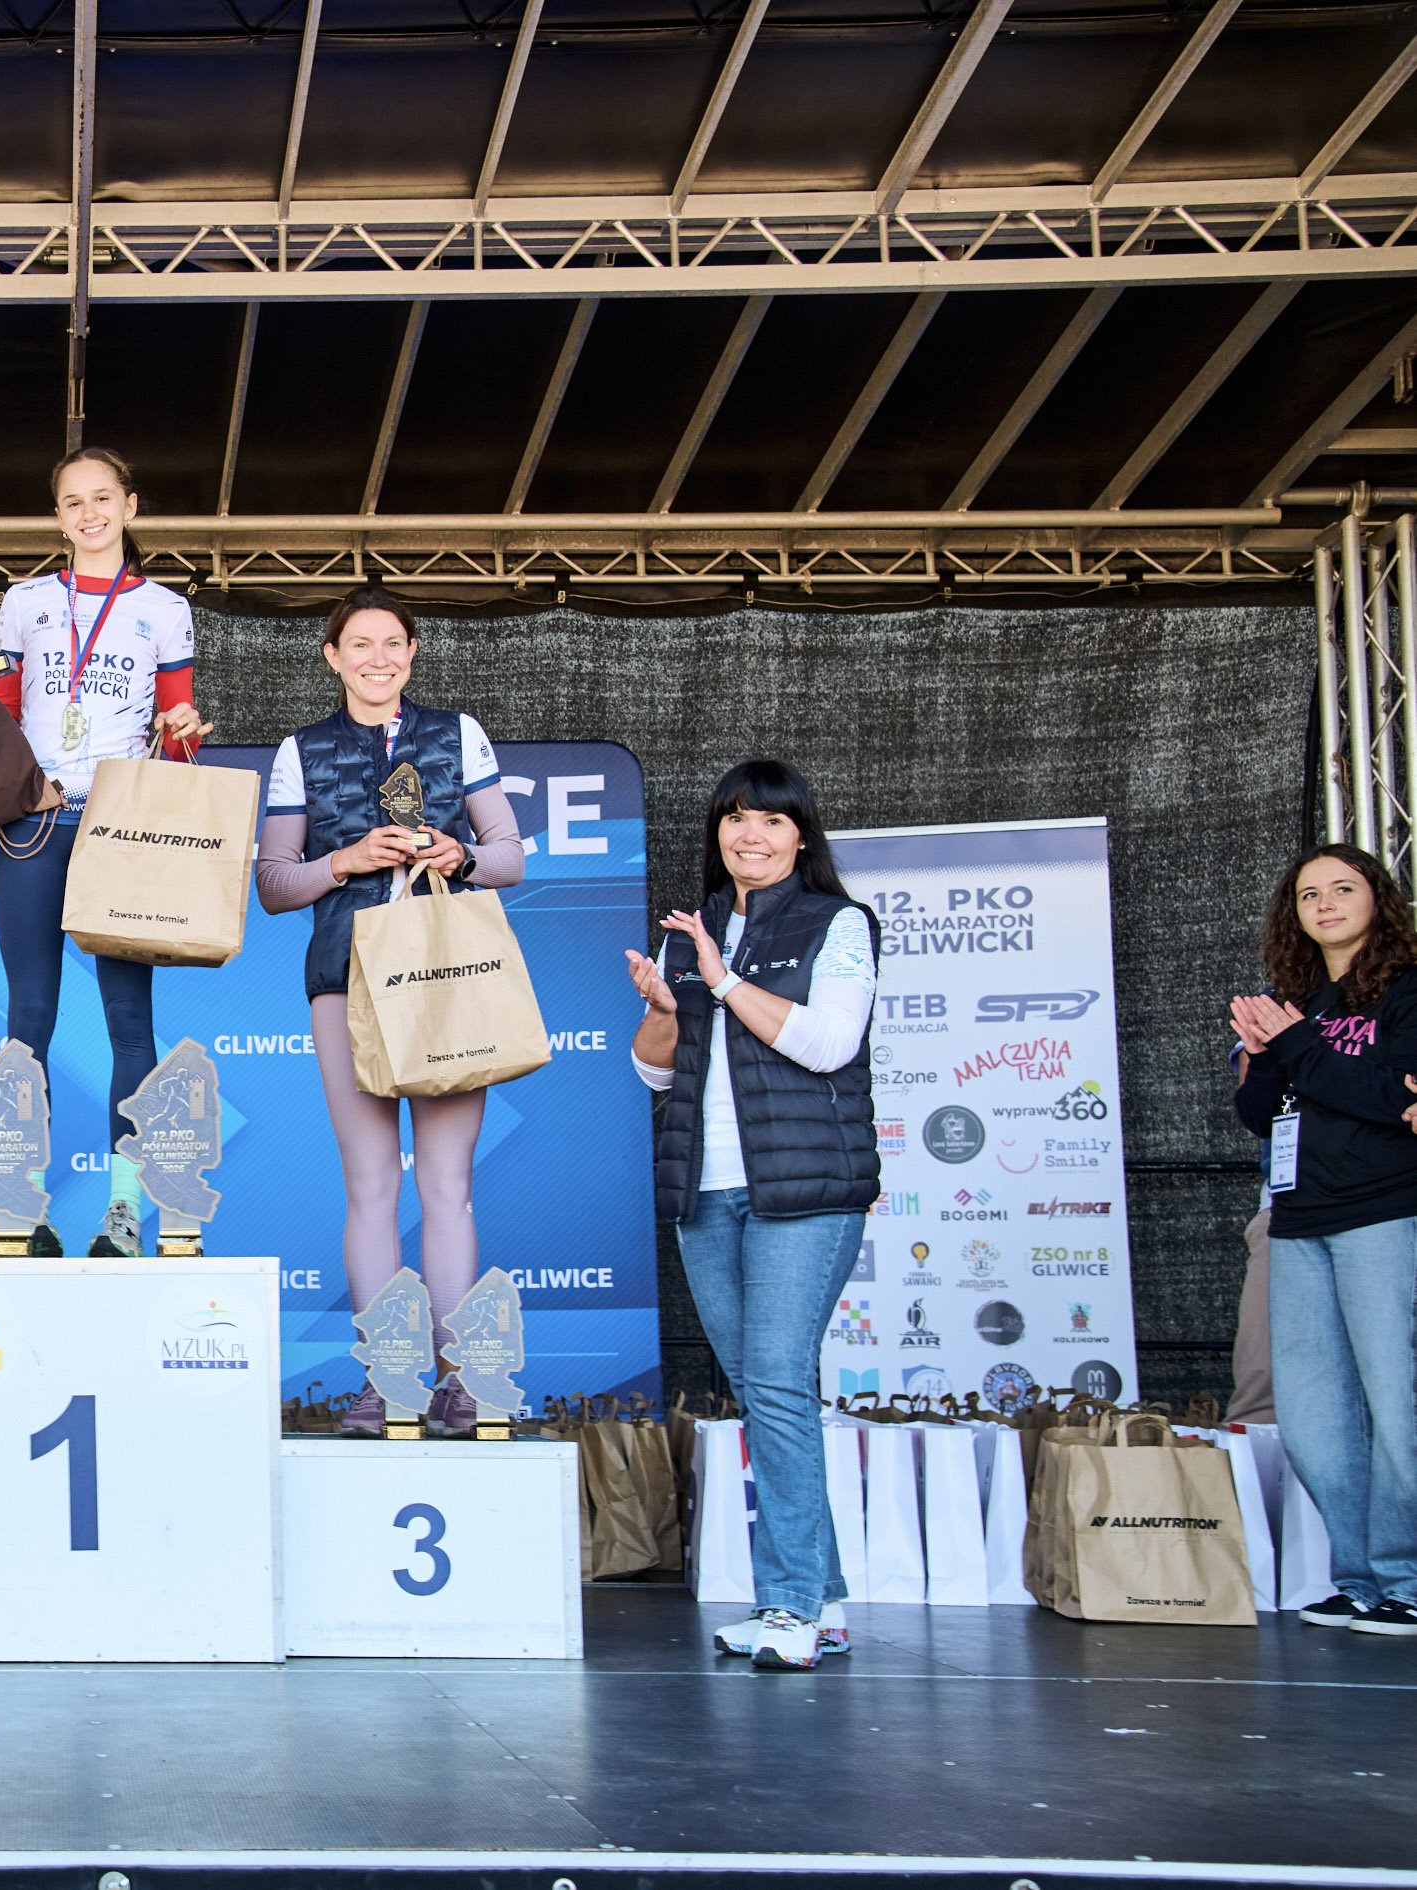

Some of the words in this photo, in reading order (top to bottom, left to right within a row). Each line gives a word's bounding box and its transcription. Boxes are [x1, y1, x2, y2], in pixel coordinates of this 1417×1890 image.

[87, 653, 135, 672] PKO
[111, 829, 222, 850] ALLNUTRITION
[873, 892, 925, 914] 12.
[948, 886, 1033, 911] PKO
[108, 909, 142, 920] Zawsze
[155, 914, 189, 924] formie!
[880, 913, 1033, 933] PÓŁMARATON
[879, 930, 1034, 956] GLIWICKI
[407, 959, 501, 983] ALLNUTRITION
[880, 994, 947, 1018] TEB
[975, 989, 1100, 1023] SFD
[880, 1024, 949, 1034] EDUKACJA
[214, 1034, 315, 1056] GLIWICE
[549, 1031, 607, 1051] WICE
[427, 1053, 455, 1063] Zawsze
[465, 1045, 497, 1057] formie!
[892, 1071, 937, 1084] Zone
[1016, 1060, 1065, 1081] TEAM
[992, 1106, 1057, 1119] wyprawy
[1054, 1100, 1107, 1120] 360
[151, 1130, 195, 1141] 12.PKO
[1044, 1138, 1111, 1153] Family
[153, 1151, 197, 1160] GLIWICKI
[1044, 1155, 1099, 1167] Smile
[1031, 1247, 1068, 1261] ZSO
[1073, 1250, 1092, 1261] nr
[1097, 1247, 1108, 1261] 8
[510, 1268, 613, 1289] GLIWICE
[1032, 1264, 1109, 1276] GLIWICE
[829, 1329, 872, 1340] PIXEL
[900, 1337, 941, 1346] AIR
[161, 1338, 248, 1359] MZUK.PL
[169, 1361, 243, 1369] GLIWICE
[30, 1394, 100, 1551] 1
[1110, 1517, 1219, 1529] ALLNUTRITION
[392, 1502, 451, 1596] 3
[1126, 1596, 1161, 1605] Zawsze
[1173, 1598, 1206, 1607] formie!
